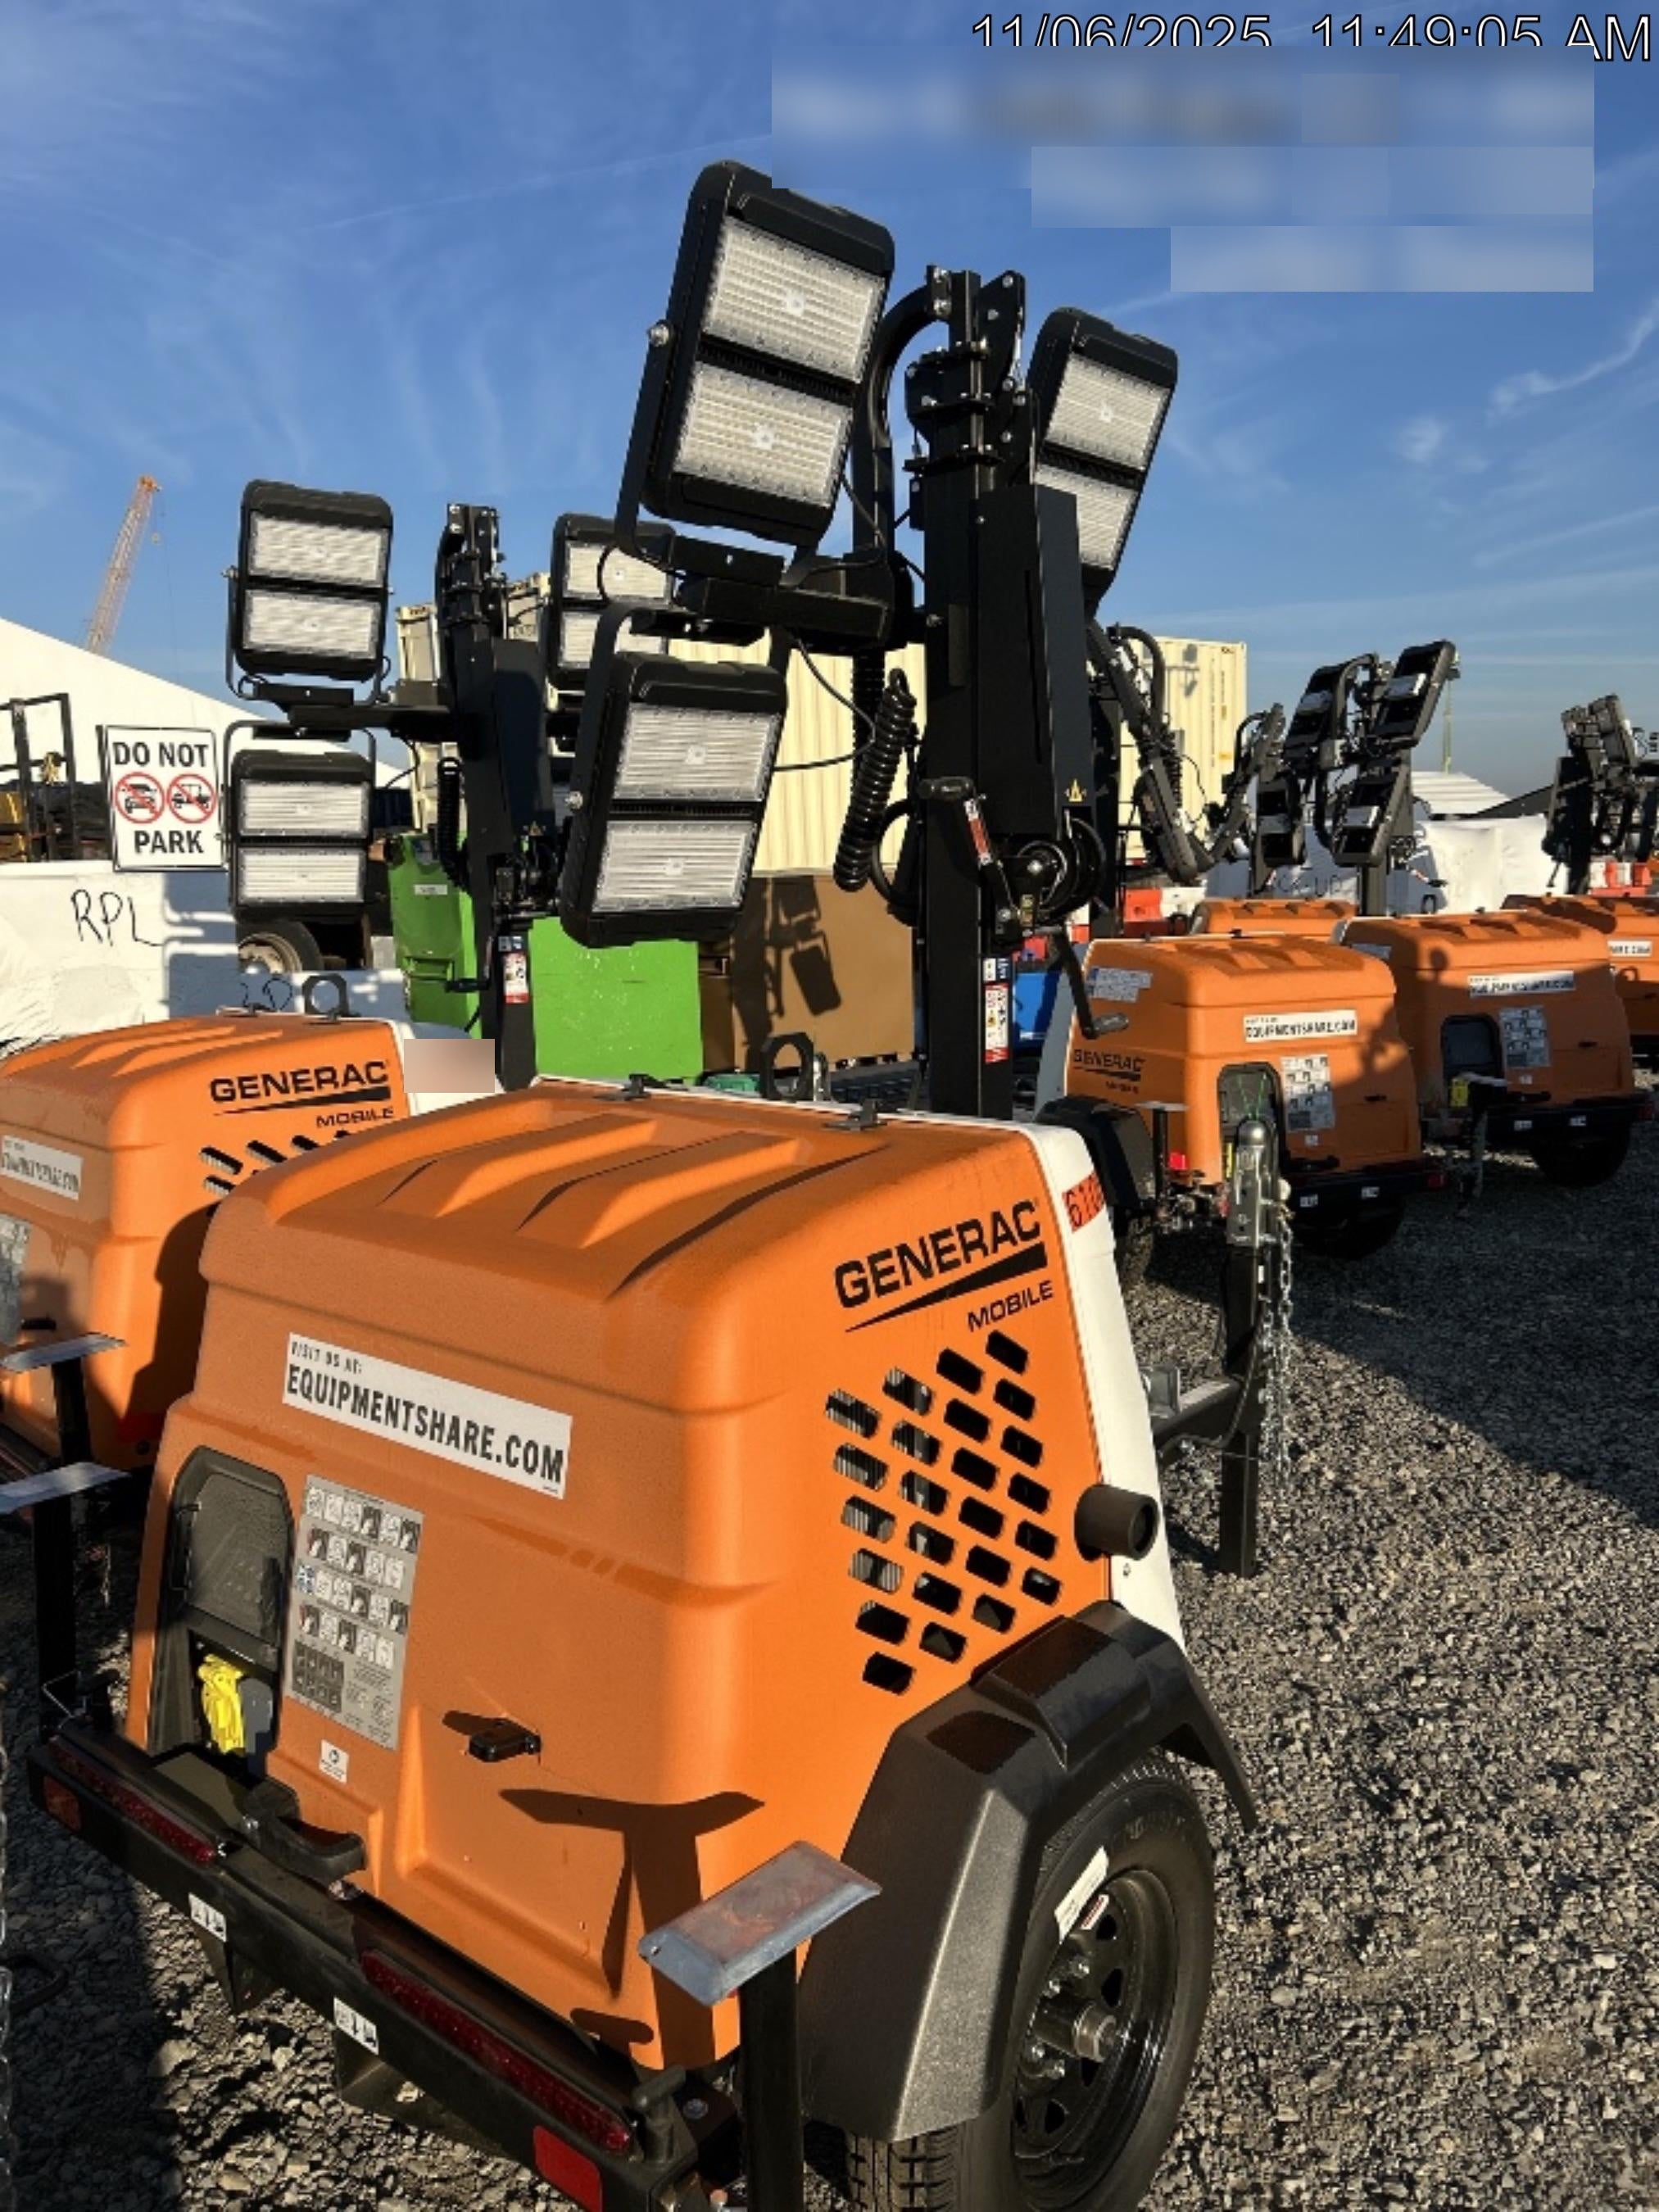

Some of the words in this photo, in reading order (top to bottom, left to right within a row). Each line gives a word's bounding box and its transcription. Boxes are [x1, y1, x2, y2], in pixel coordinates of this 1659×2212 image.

[112, 741, 150, 767] DO
[159, 741, 209, 768] NOT
[134, 830, 203, 854] PARK
[70, 889, 164, 947] RPL
[210, 1061, 389, 1103] GENERAC
[315, 1106, 395, 1129] MOBILE
[834, 1199, 1041, 1308] GENERAC
[968, 1279, 1054, 1332] MOBILE
[286, 1363, 564, 1484] EQUIPMENTSHARE.COM
